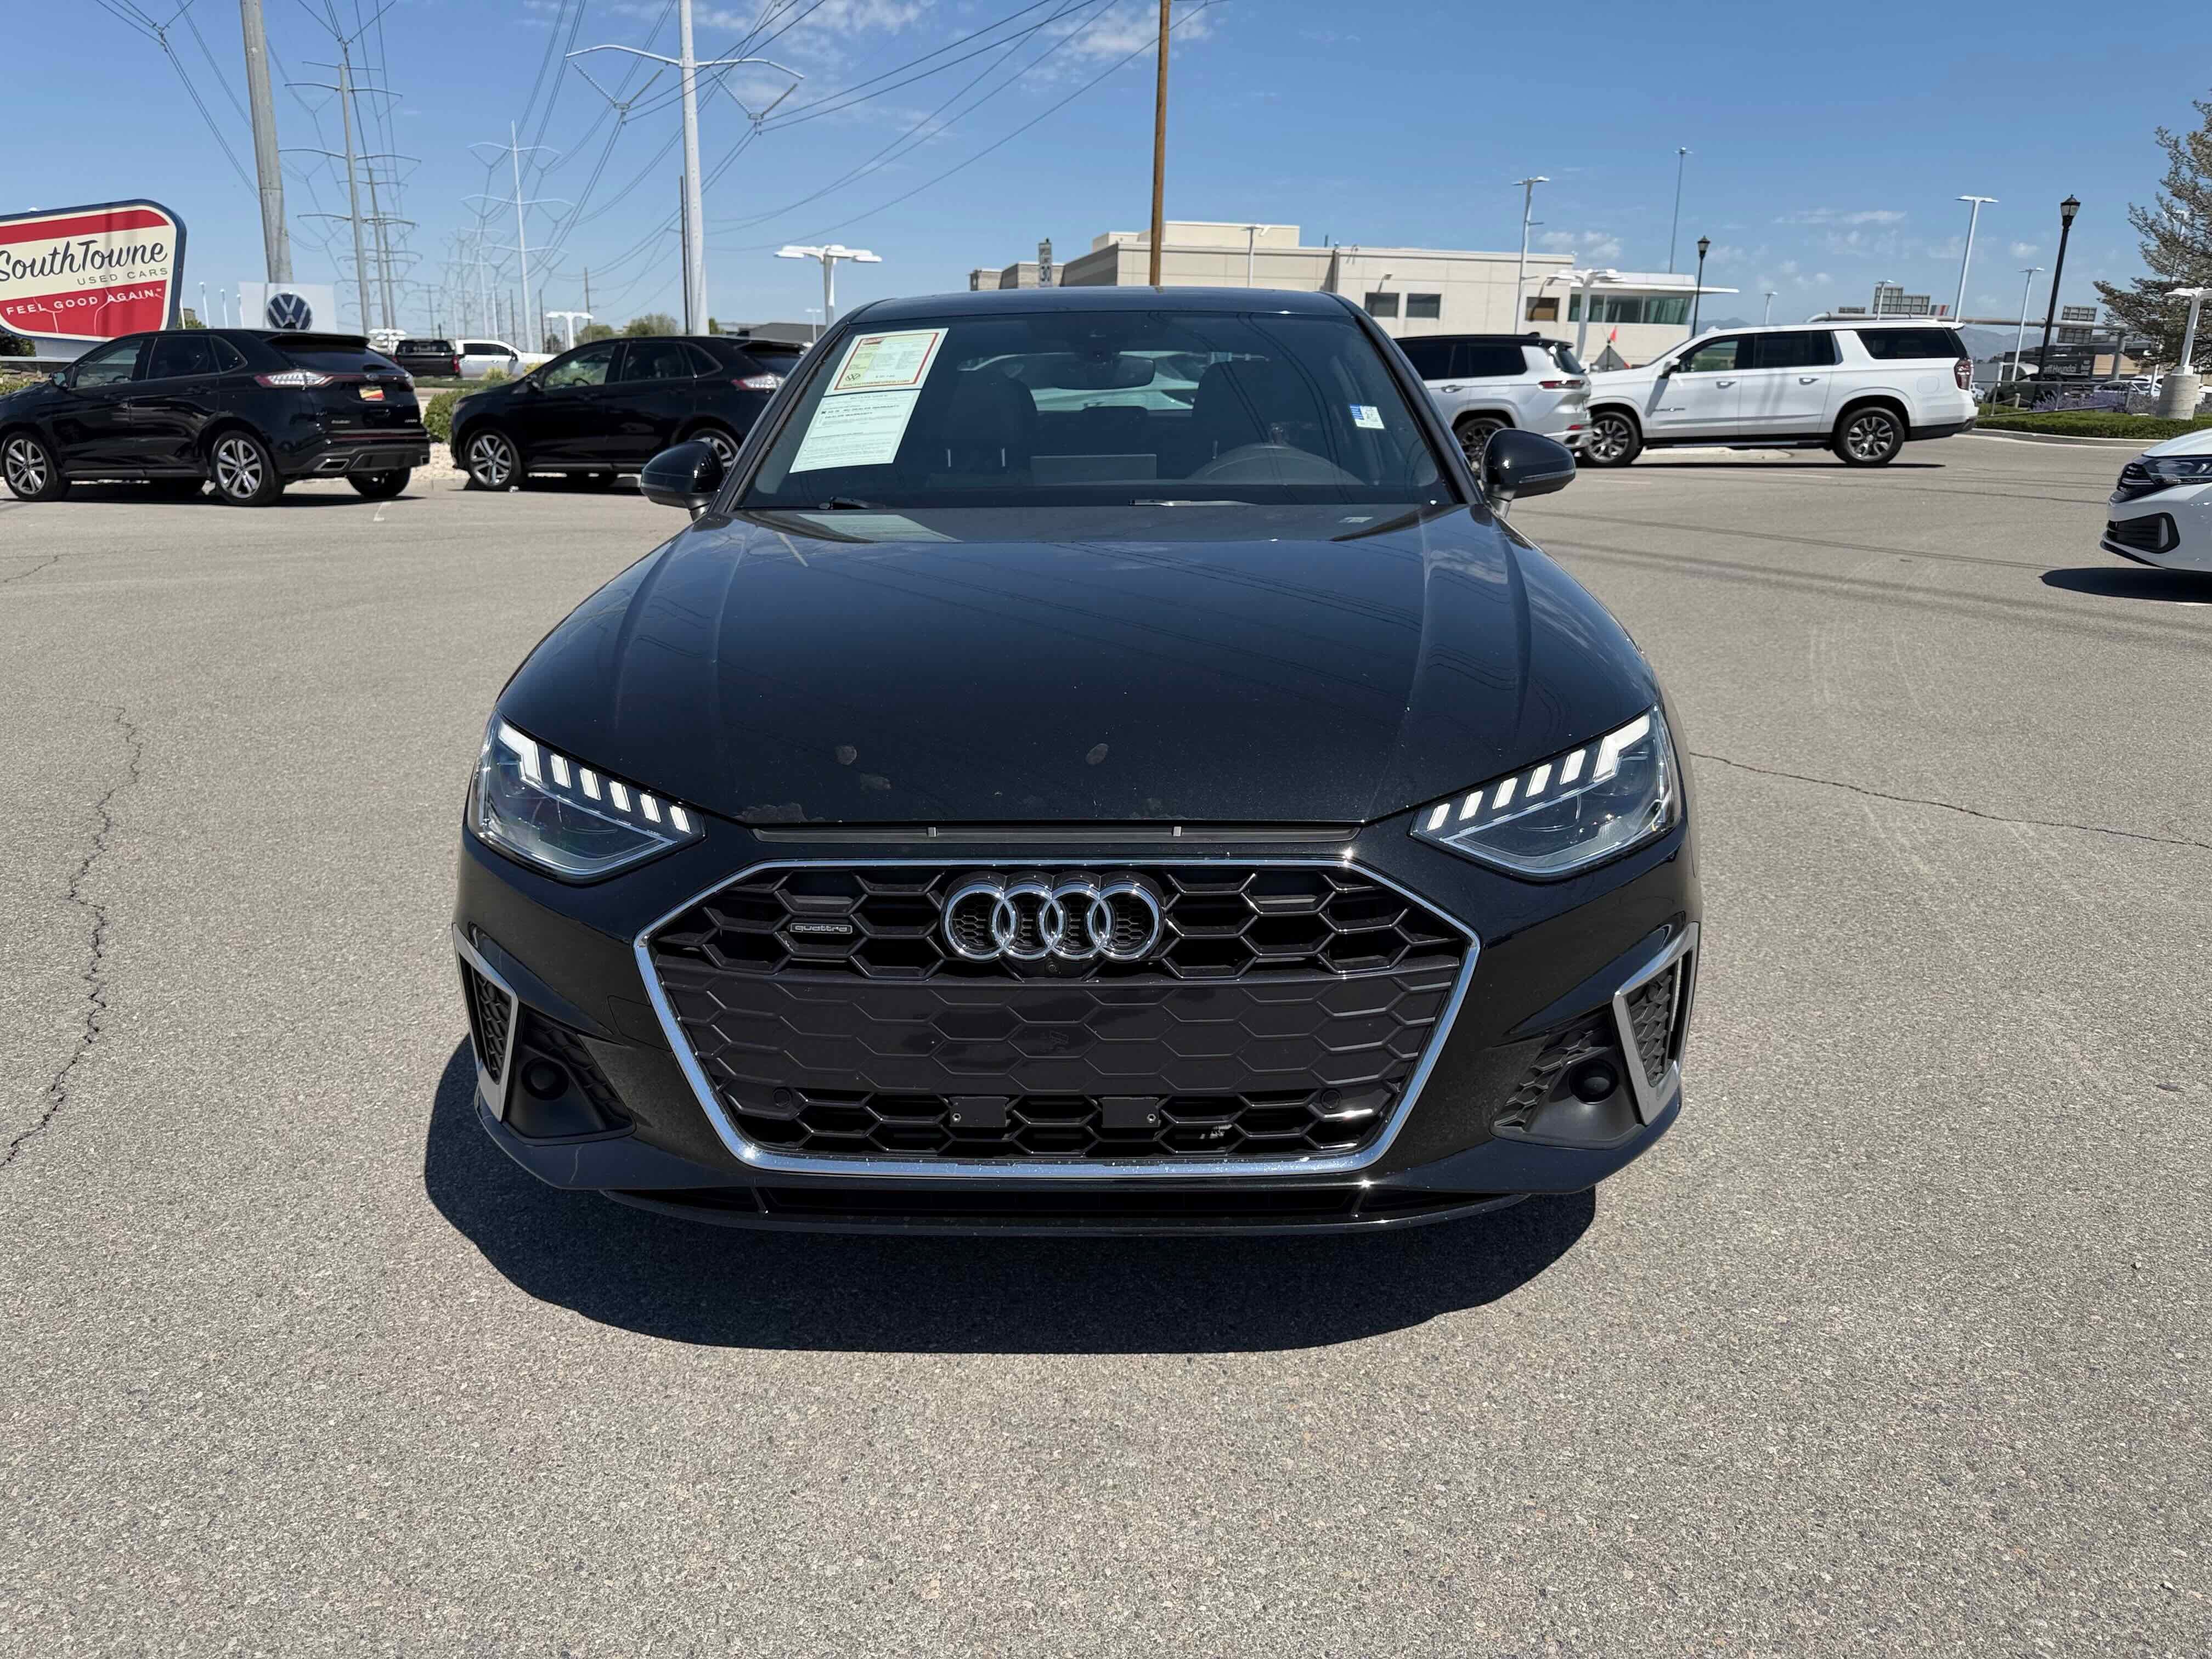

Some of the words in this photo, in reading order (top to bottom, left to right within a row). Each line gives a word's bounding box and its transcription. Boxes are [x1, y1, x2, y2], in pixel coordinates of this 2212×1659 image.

[77, 274, 118, 285] USED
[127, 268, 168, 279] CARS
[6, 303, 47, 316] FEEL
[54, 296, 98, 309] GOOD
